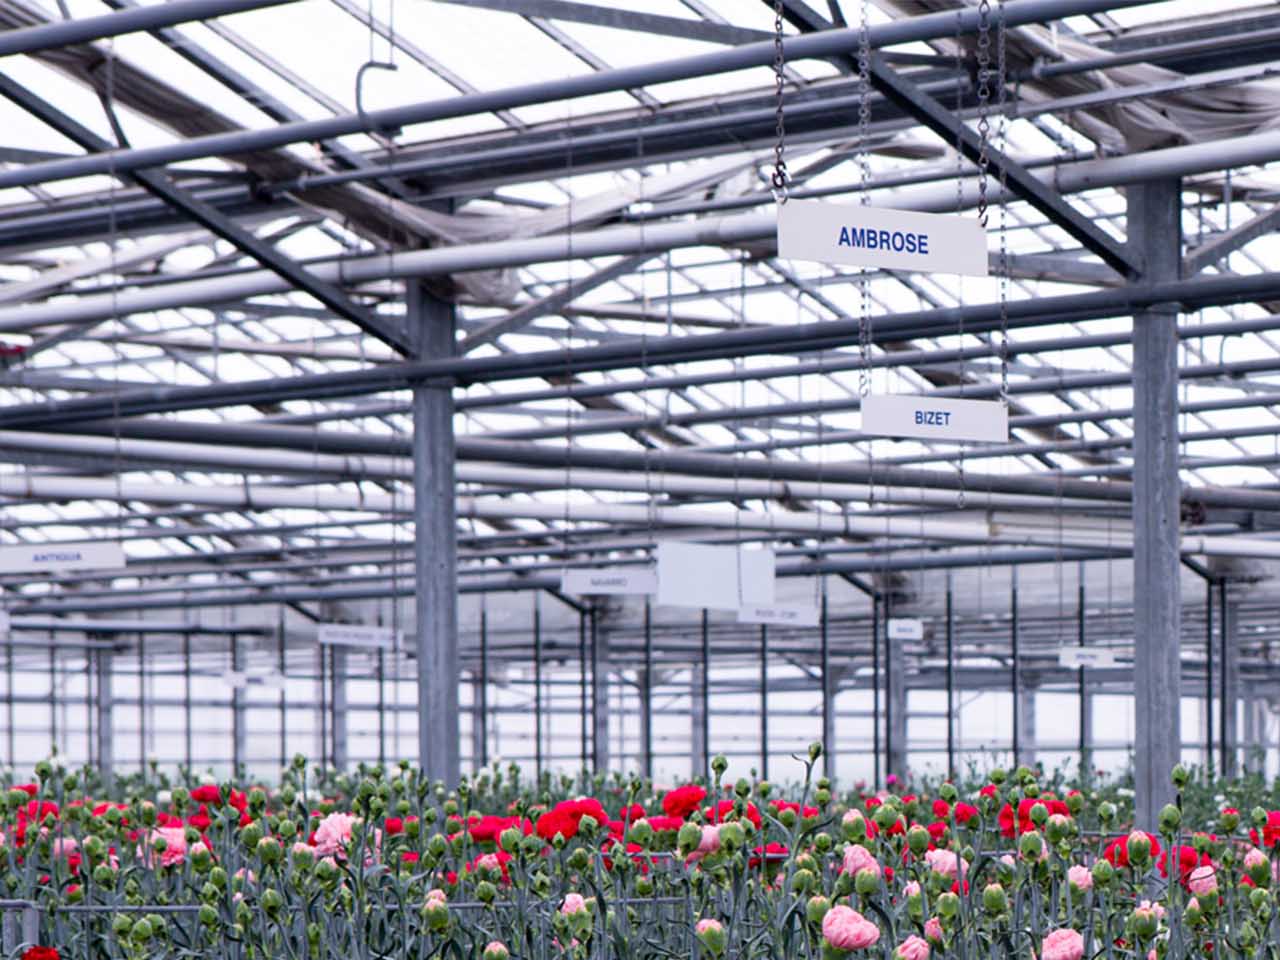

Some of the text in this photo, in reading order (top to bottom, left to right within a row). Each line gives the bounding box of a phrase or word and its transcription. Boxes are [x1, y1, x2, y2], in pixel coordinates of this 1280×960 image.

[838, 226, 929, 254] AMBROSE
[914, 410, 951, 426] BIZET
[33, 552, 82, 562] ANTIGUA
